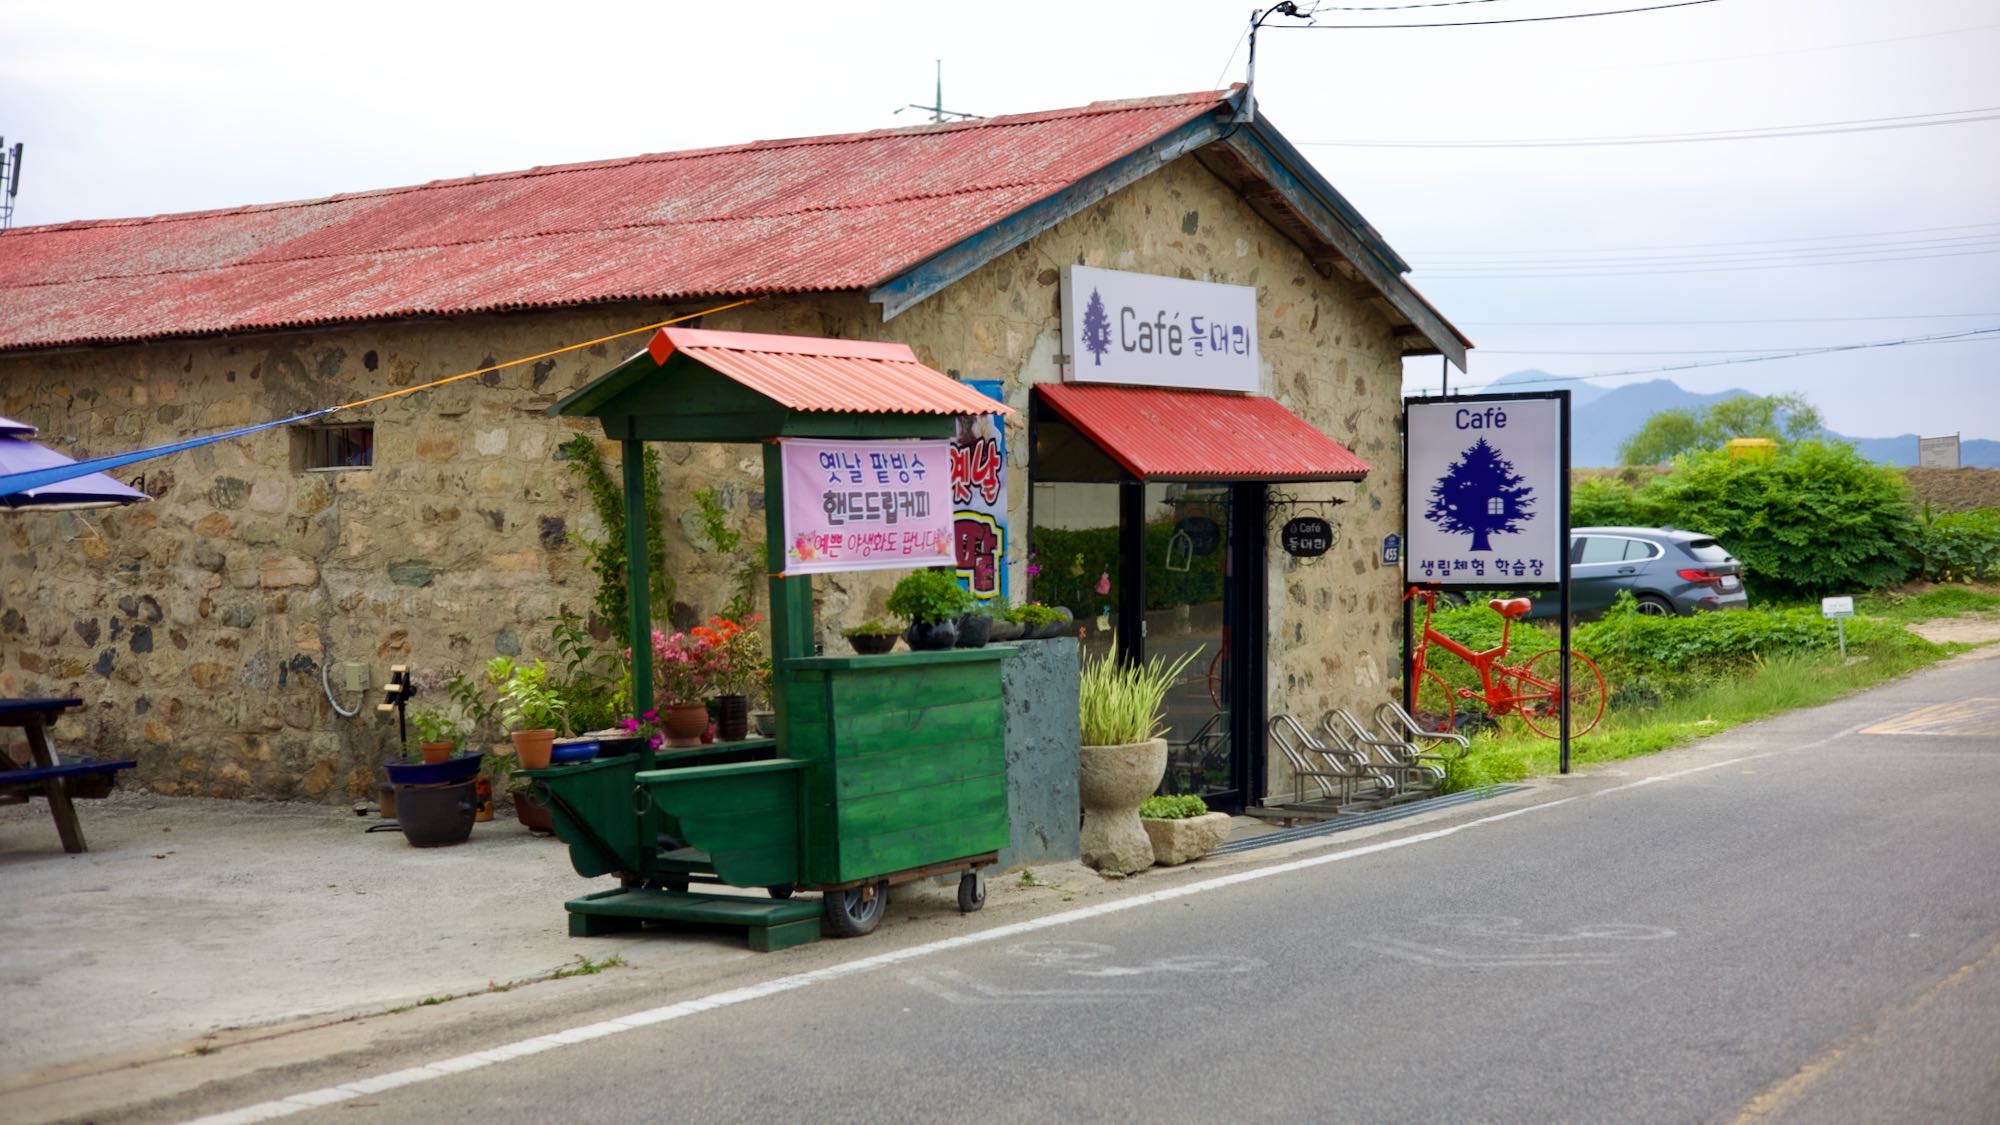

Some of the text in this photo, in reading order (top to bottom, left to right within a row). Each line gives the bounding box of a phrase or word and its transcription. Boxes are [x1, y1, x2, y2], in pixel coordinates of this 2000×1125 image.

[1120, 306, 1183, 356] Café
[1455, 407, 1507, 430] Café
[819, 451, 926, 484] 옛날 팥빙수
[823, 489, 931, 526] 핸드드립커피
[1299, 522, 1321, 533] Café
[814, 533, 843, 558] 예쁜
[848, 531, 897, 557] 야생화도
[1384, 547, 1398, 561] 455
[1420, 558, 1544, 577] 생림체험 학습장
